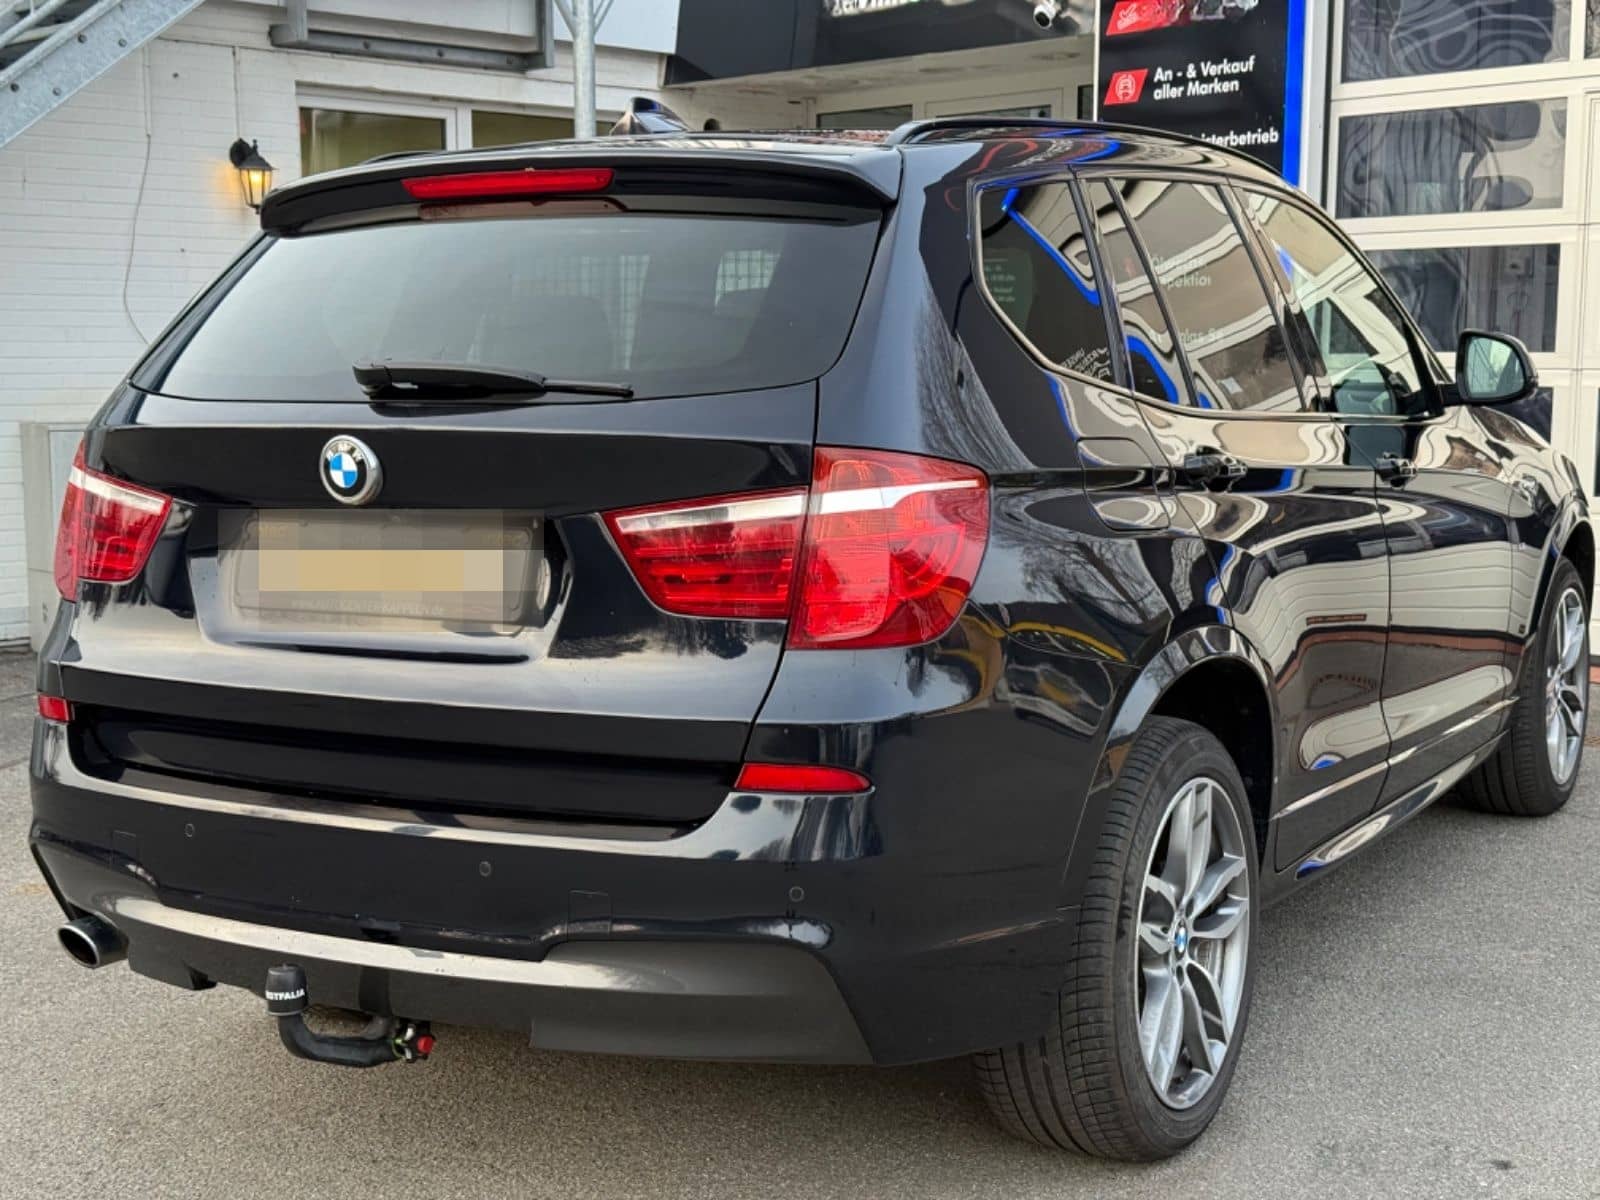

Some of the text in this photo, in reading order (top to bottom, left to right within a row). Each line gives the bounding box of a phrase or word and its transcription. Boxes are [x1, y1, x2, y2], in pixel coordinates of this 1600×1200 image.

[1154, 67, 1173, 83] An
[1186, 64, 1196, 79] &
[1200, 56, 1256, 77] Verkauf
[1153, 78, 1240, 101] aller Marken
